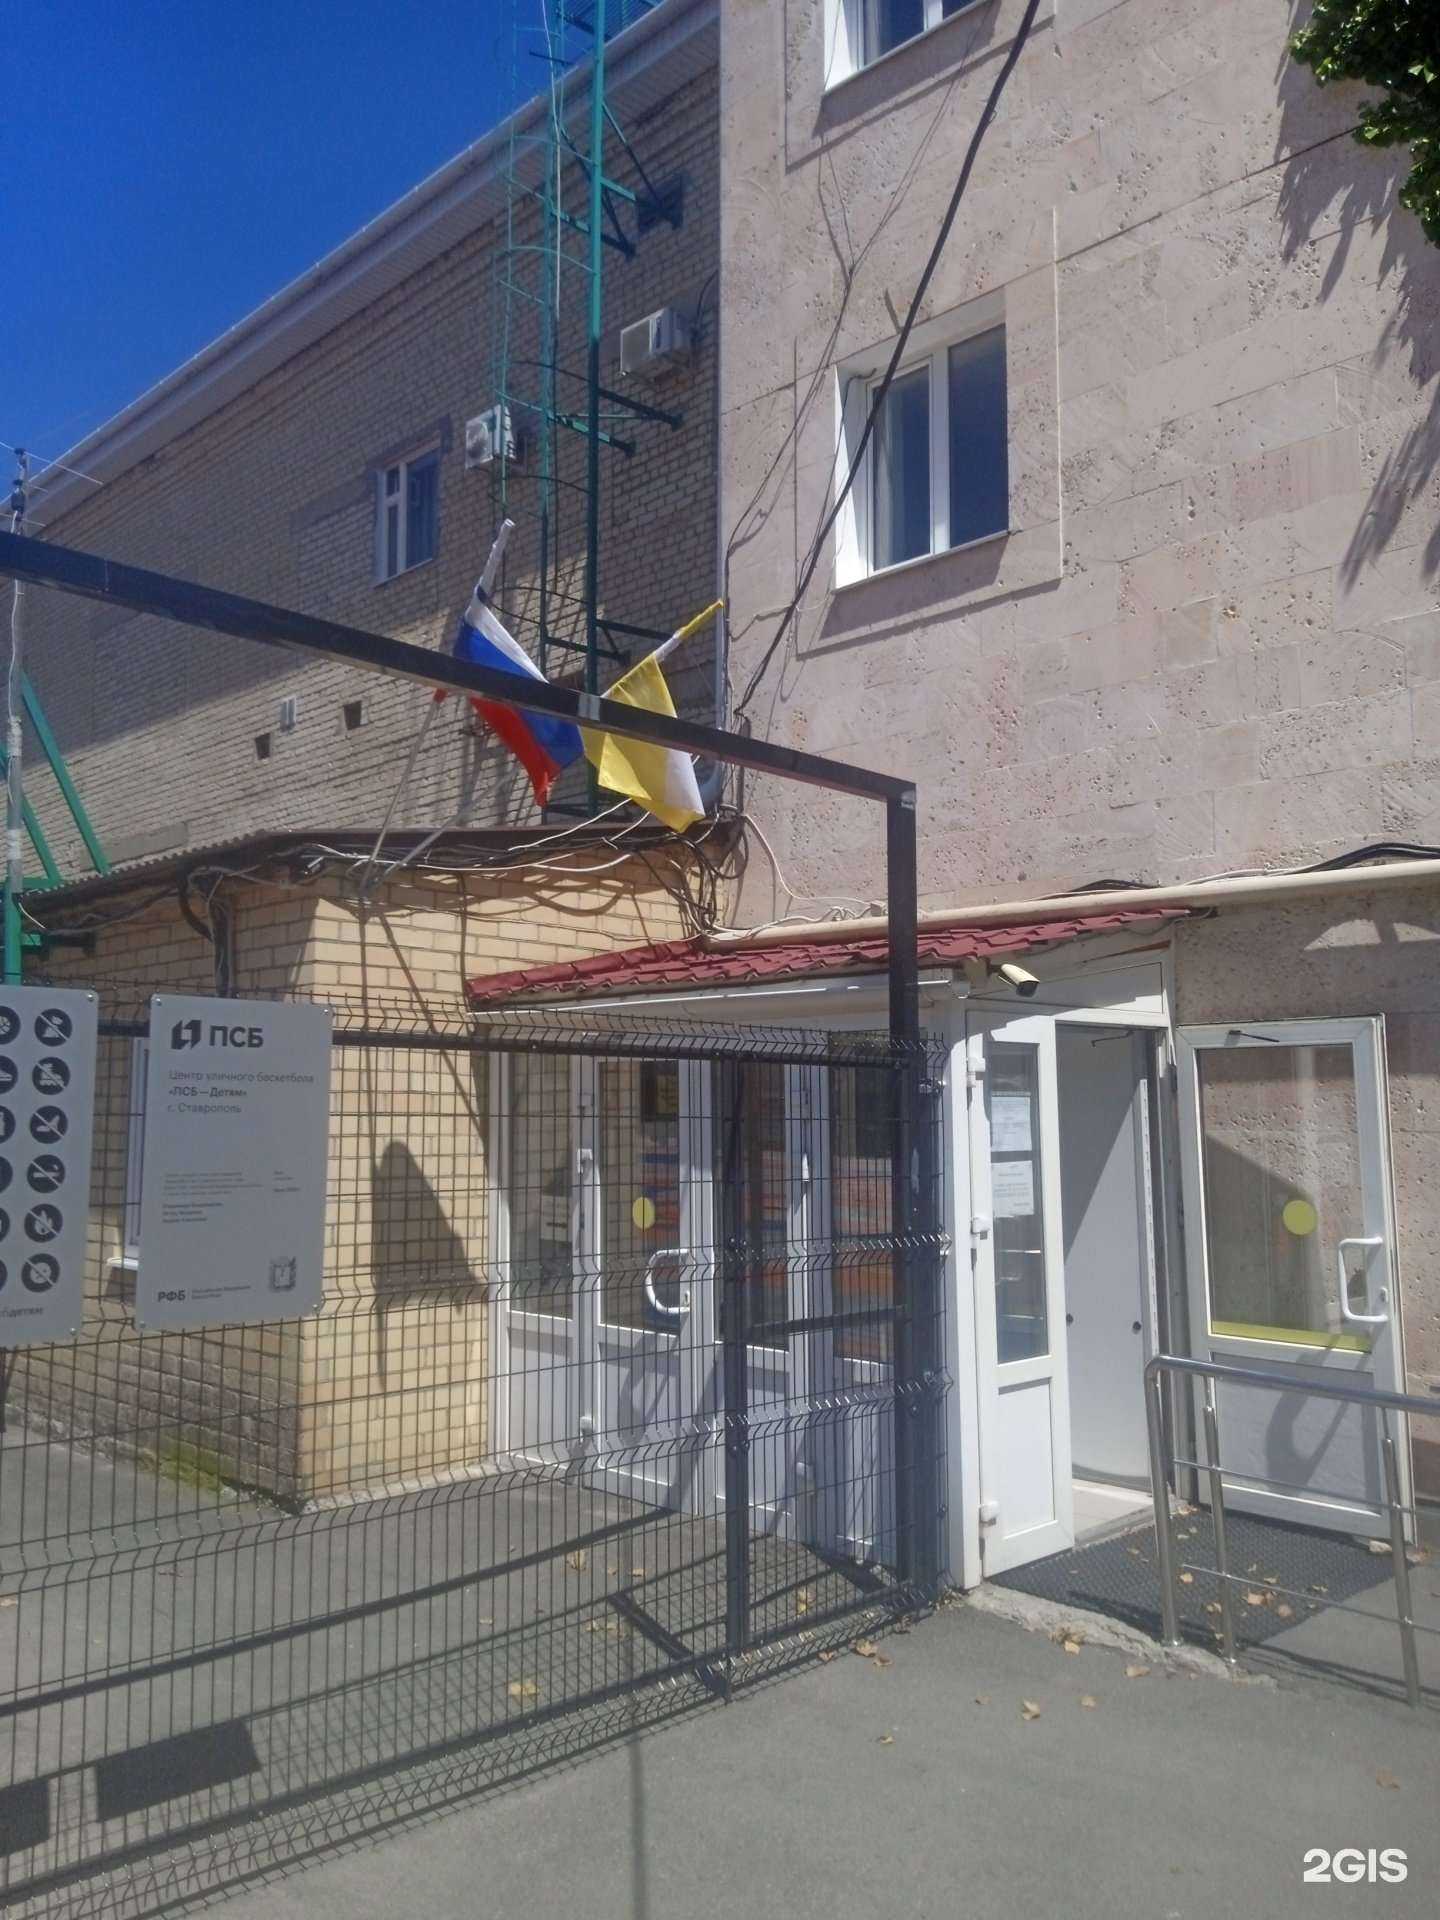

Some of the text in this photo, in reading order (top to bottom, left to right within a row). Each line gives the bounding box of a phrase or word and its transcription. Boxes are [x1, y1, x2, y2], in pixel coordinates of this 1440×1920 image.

[209, 1025, 264, 1048] ПСБ
[168, 1070, 203, 1082] Центр
[178, 1103, 242, 1114] Ставрополь
